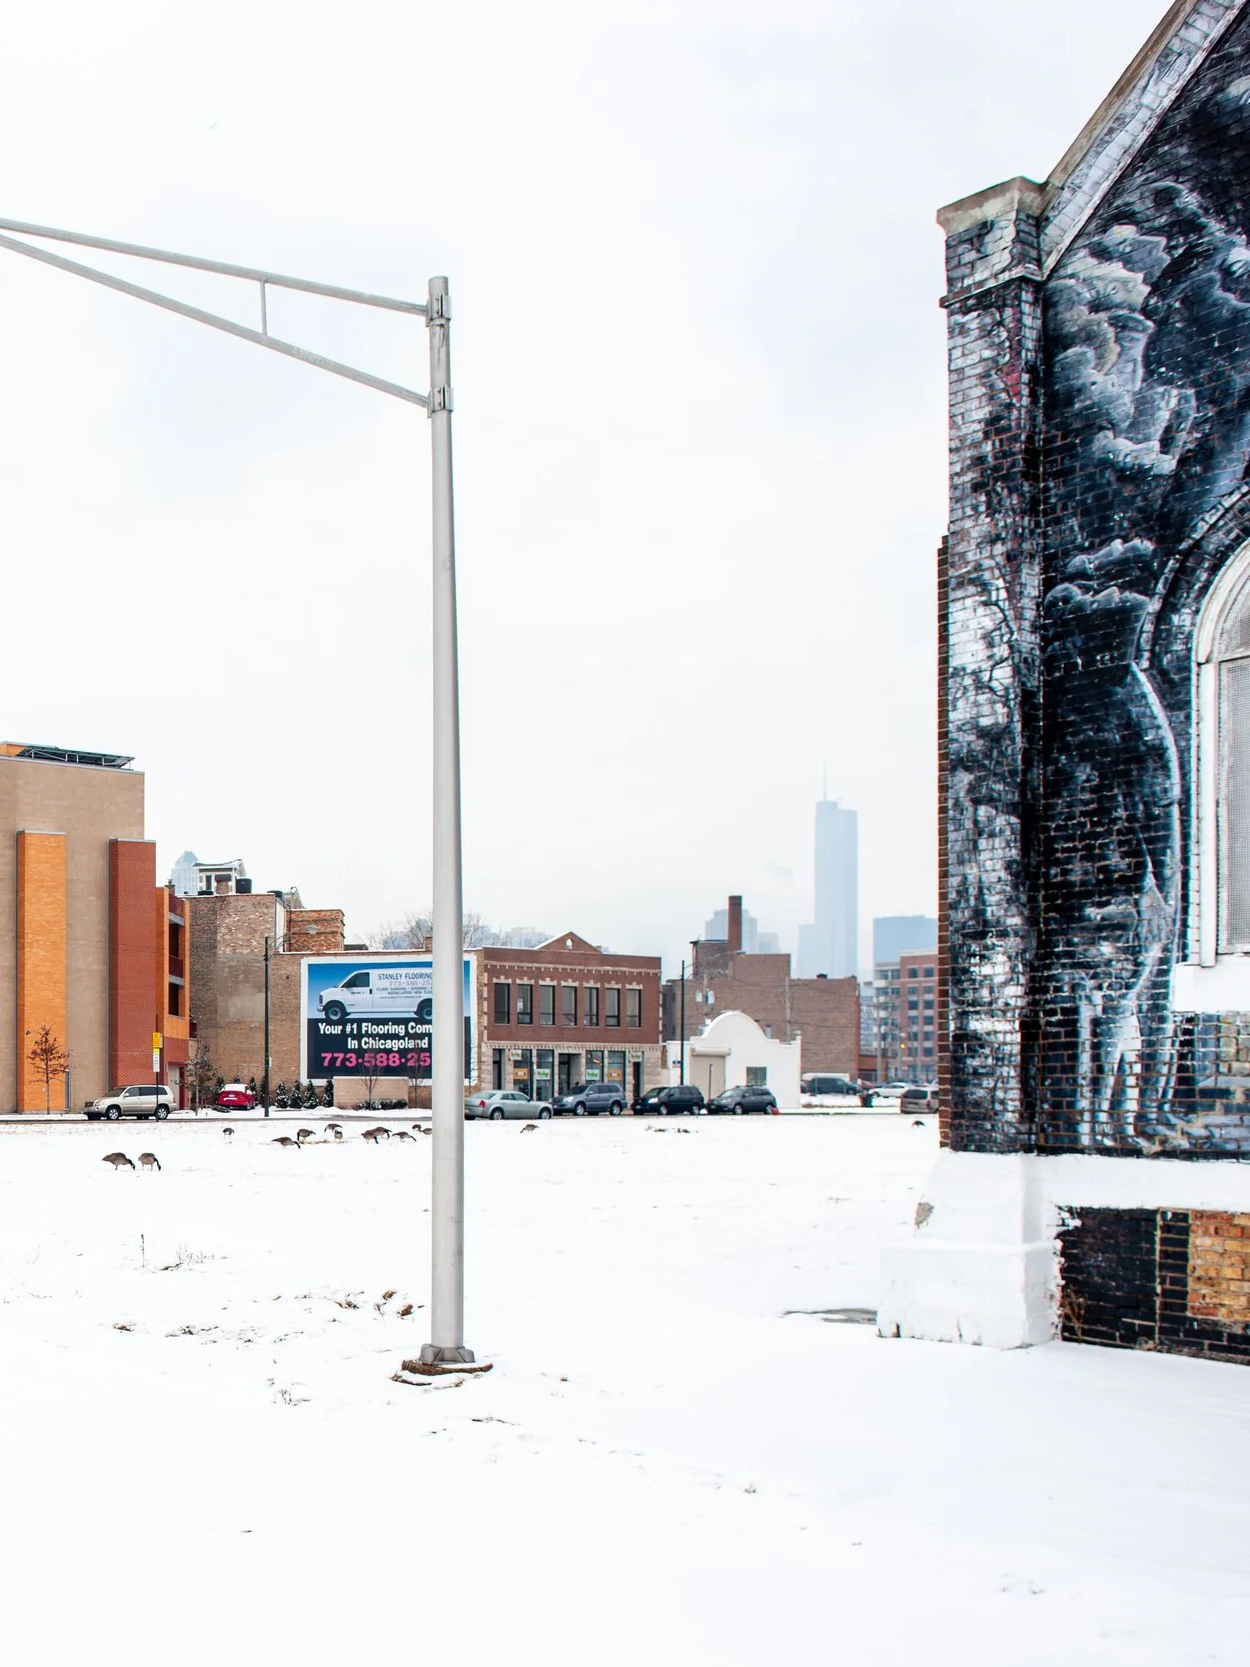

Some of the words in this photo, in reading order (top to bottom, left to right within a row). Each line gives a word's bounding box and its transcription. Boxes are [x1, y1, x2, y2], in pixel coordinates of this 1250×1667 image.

[318, 1023, 342, 1034] Your
[346, 1023, 357, 1034] #1
[362, 1022, 405, 1036] Flooring
[348, 1037, 358, 1049] In
[362, 1037, 428, 1051] Chicagoland
